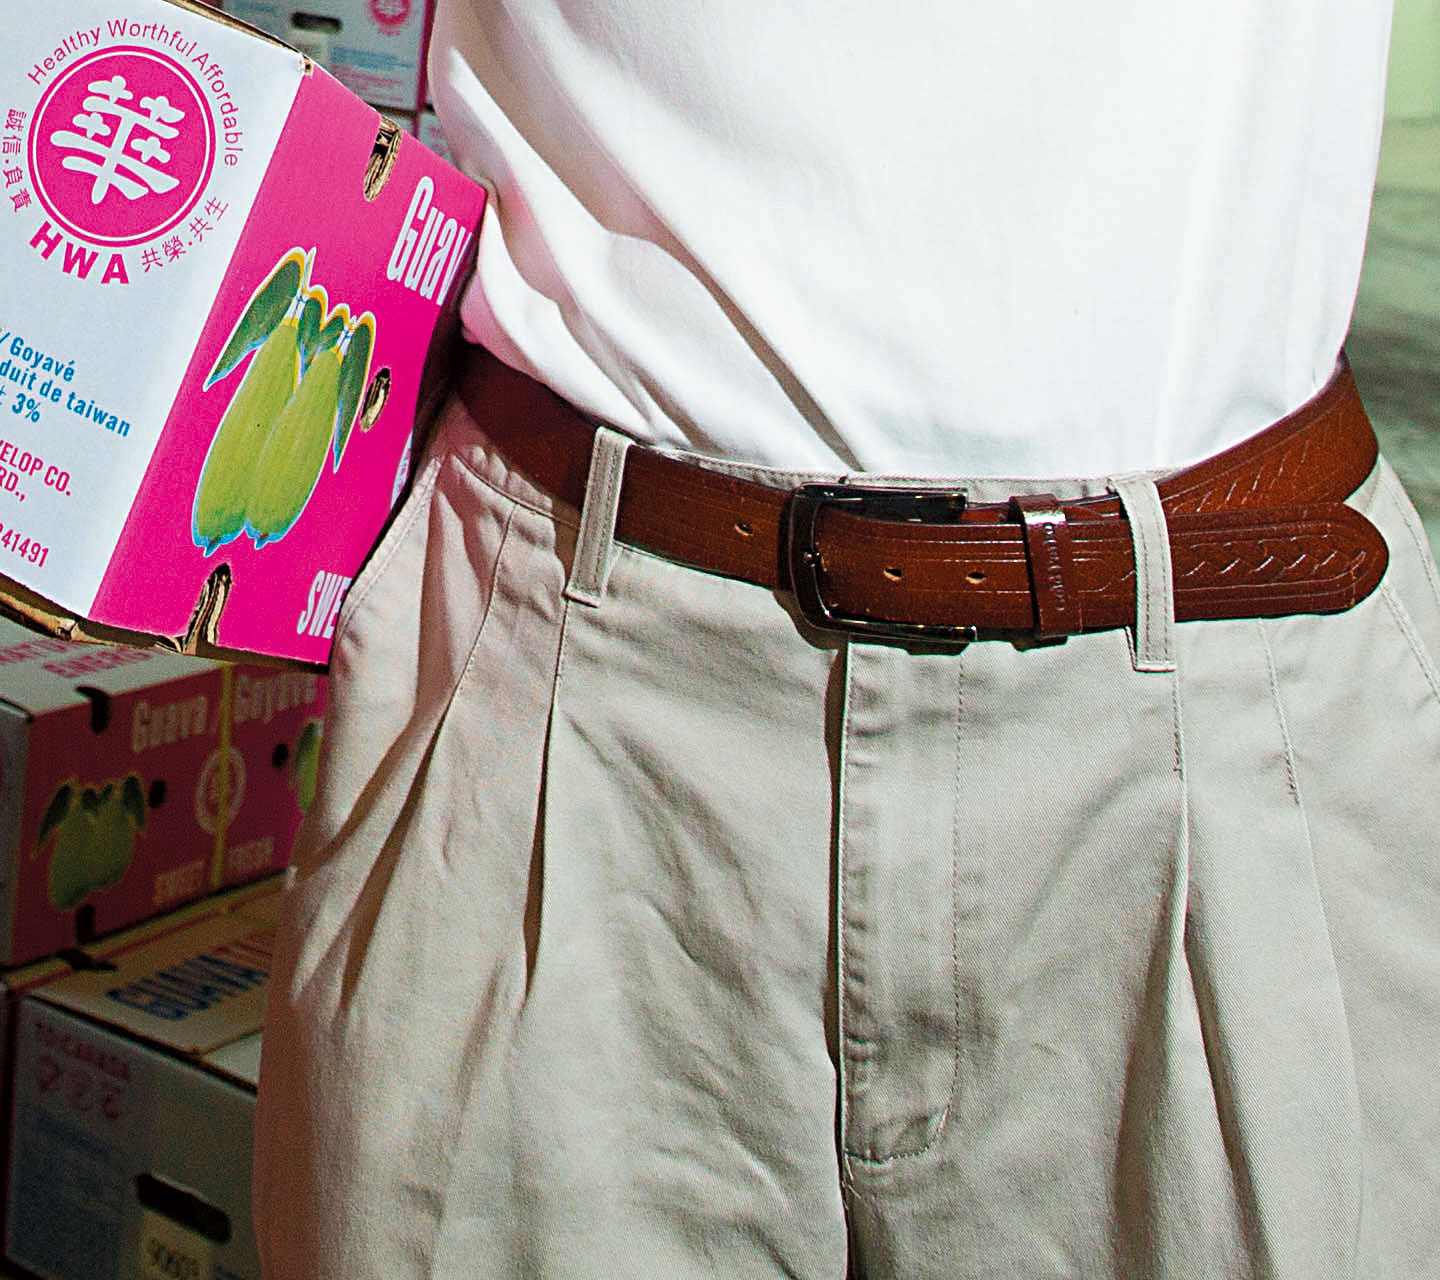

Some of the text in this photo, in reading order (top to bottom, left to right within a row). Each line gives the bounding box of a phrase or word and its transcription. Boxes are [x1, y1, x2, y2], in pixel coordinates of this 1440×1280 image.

[27, 18, 244, 167] Healthy Worthful Affordable
[29, 220, 129, 284] HWA
[387, 176, 472, 306] Guav
[9, 336, 74, 382] Goyavé
[11, 392, 40, 422] 3%
[39, 379, 62, 402] de
[66, 391, 130, 437] taiwan
[44, 465, 70, 496] CO.
[297, 570, 351, 639] SWE
